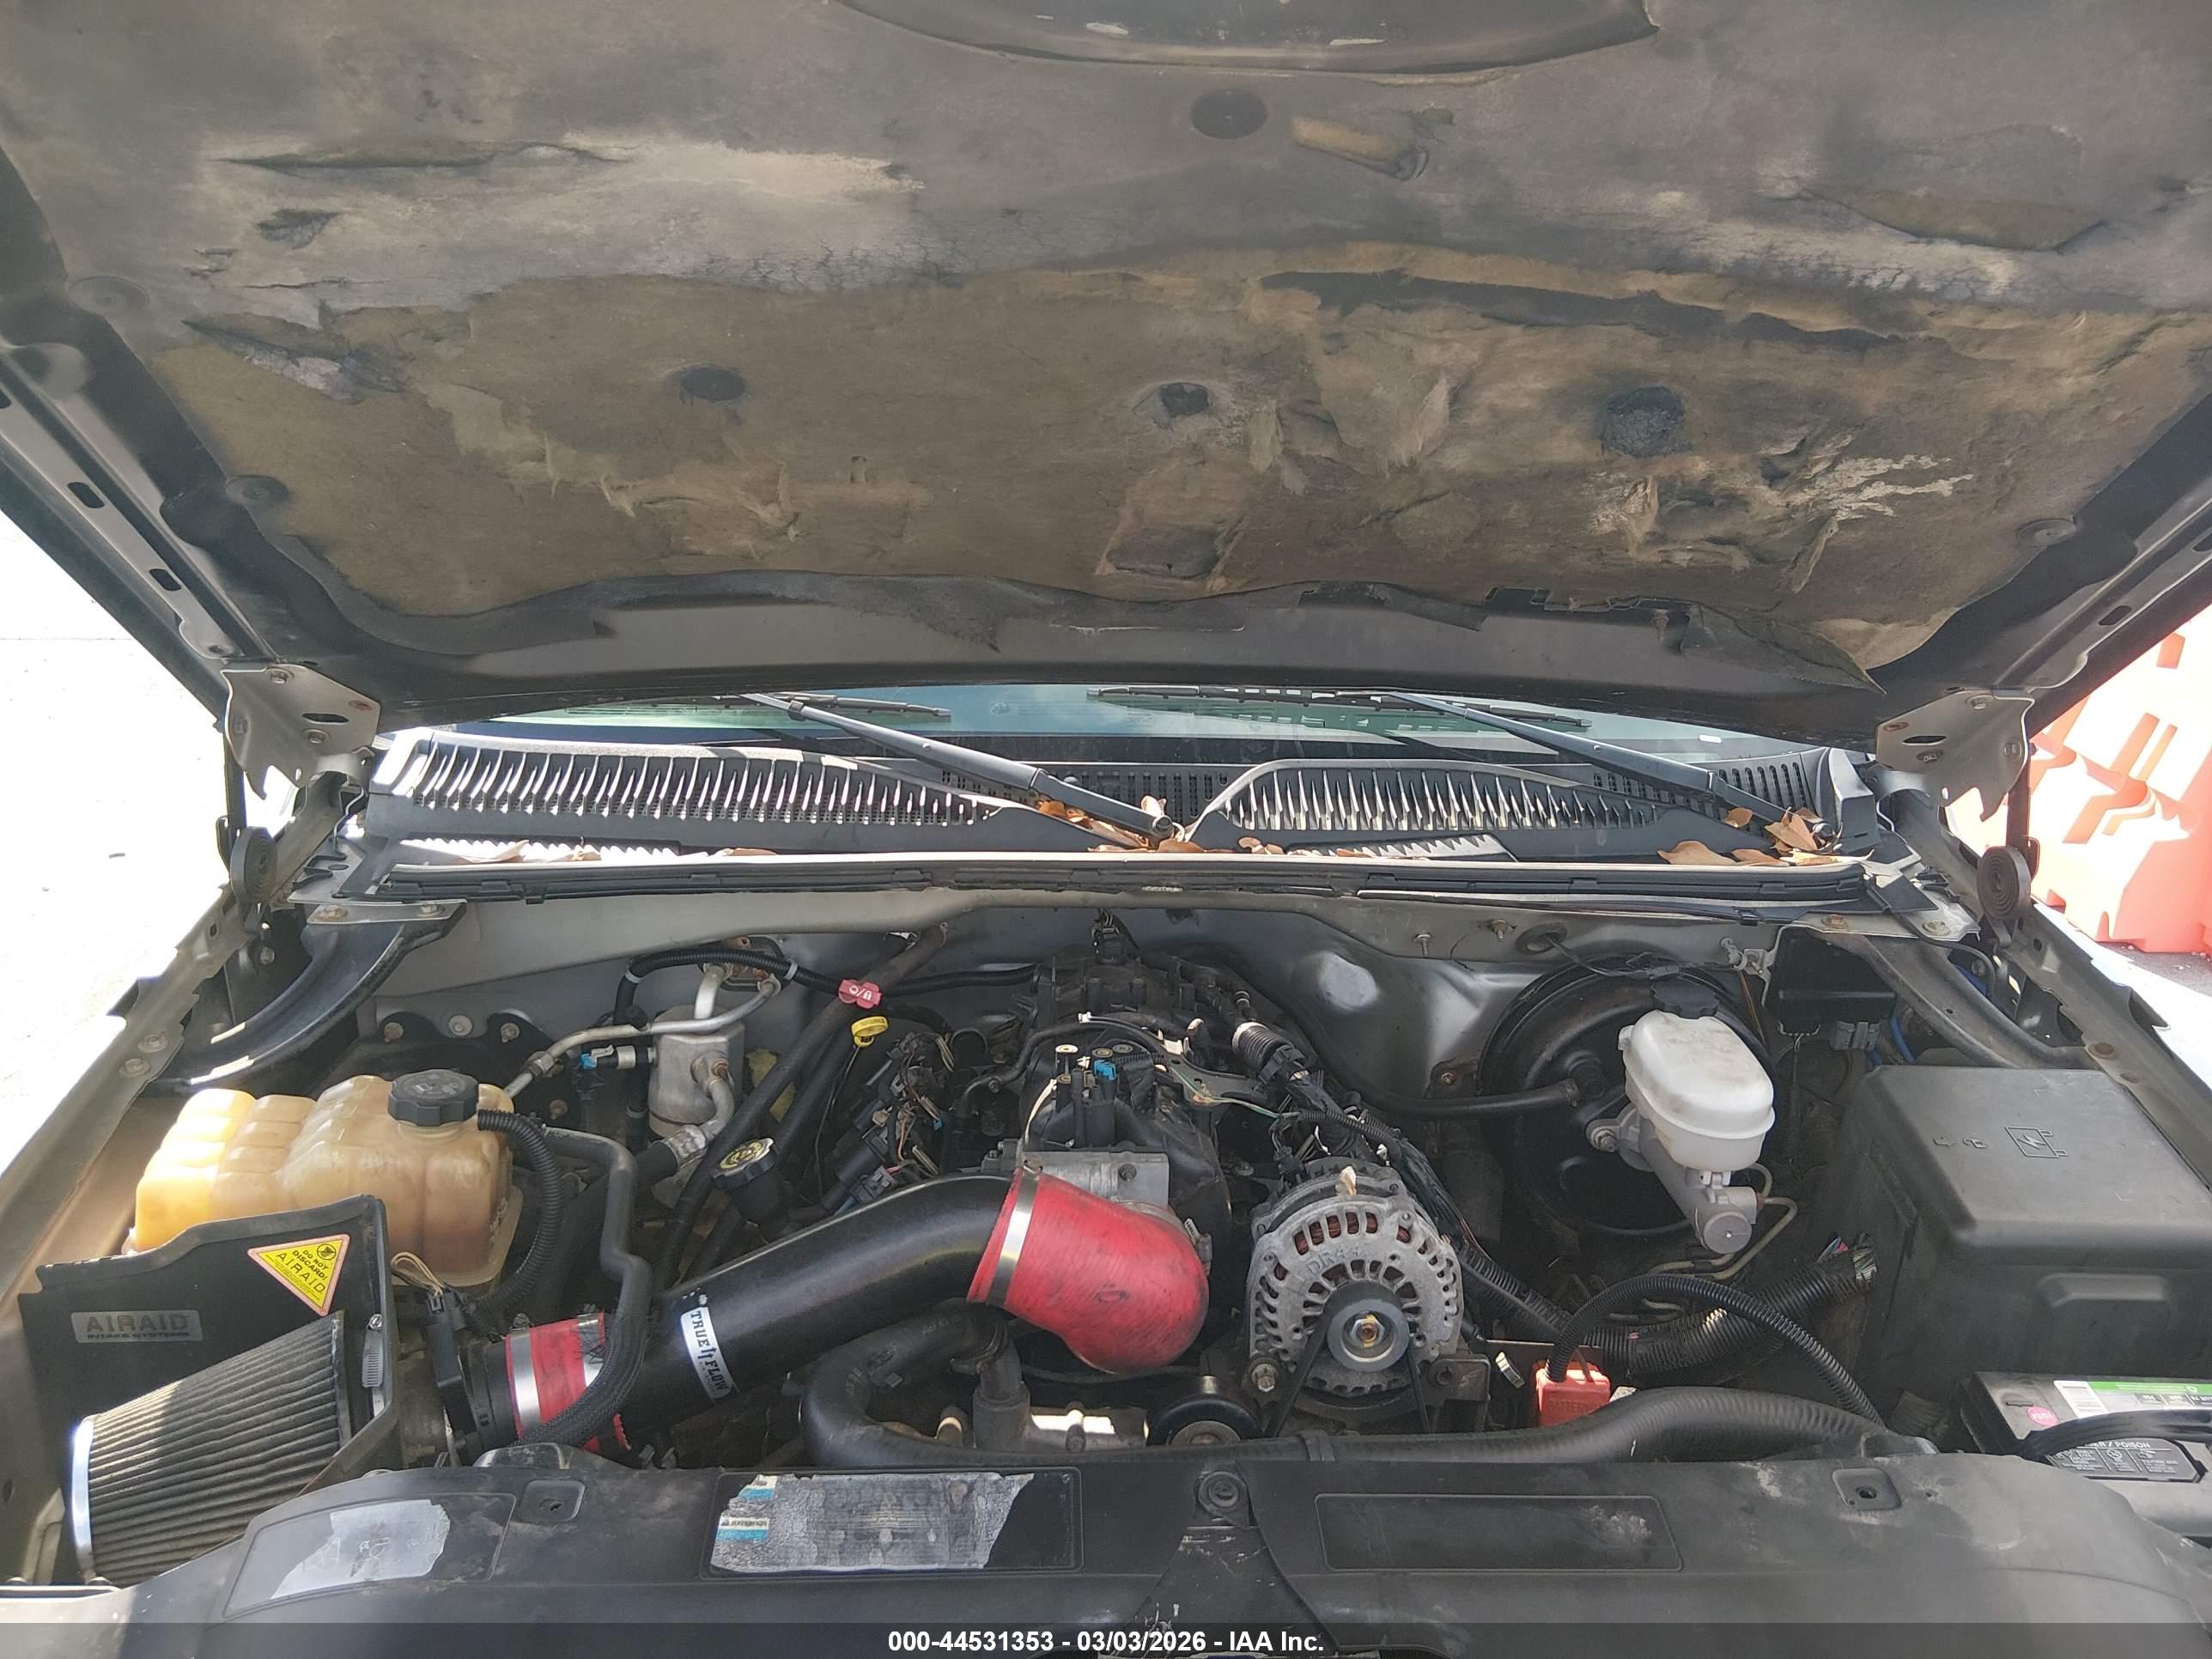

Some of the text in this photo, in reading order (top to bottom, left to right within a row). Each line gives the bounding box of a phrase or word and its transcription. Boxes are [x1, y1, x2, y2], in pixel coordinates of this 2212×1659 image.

[276, 1252, 326, 1292] AIRAID
[292, 1250, 329, 1280] DISCARD!
[302, 1249, 330, 1271] DO NOT
[87, 1314, 188, 1332] AIRAID
[690, 1310, 711, 1347] TRUE
[705, 1359, 729, 1390] FLOW
